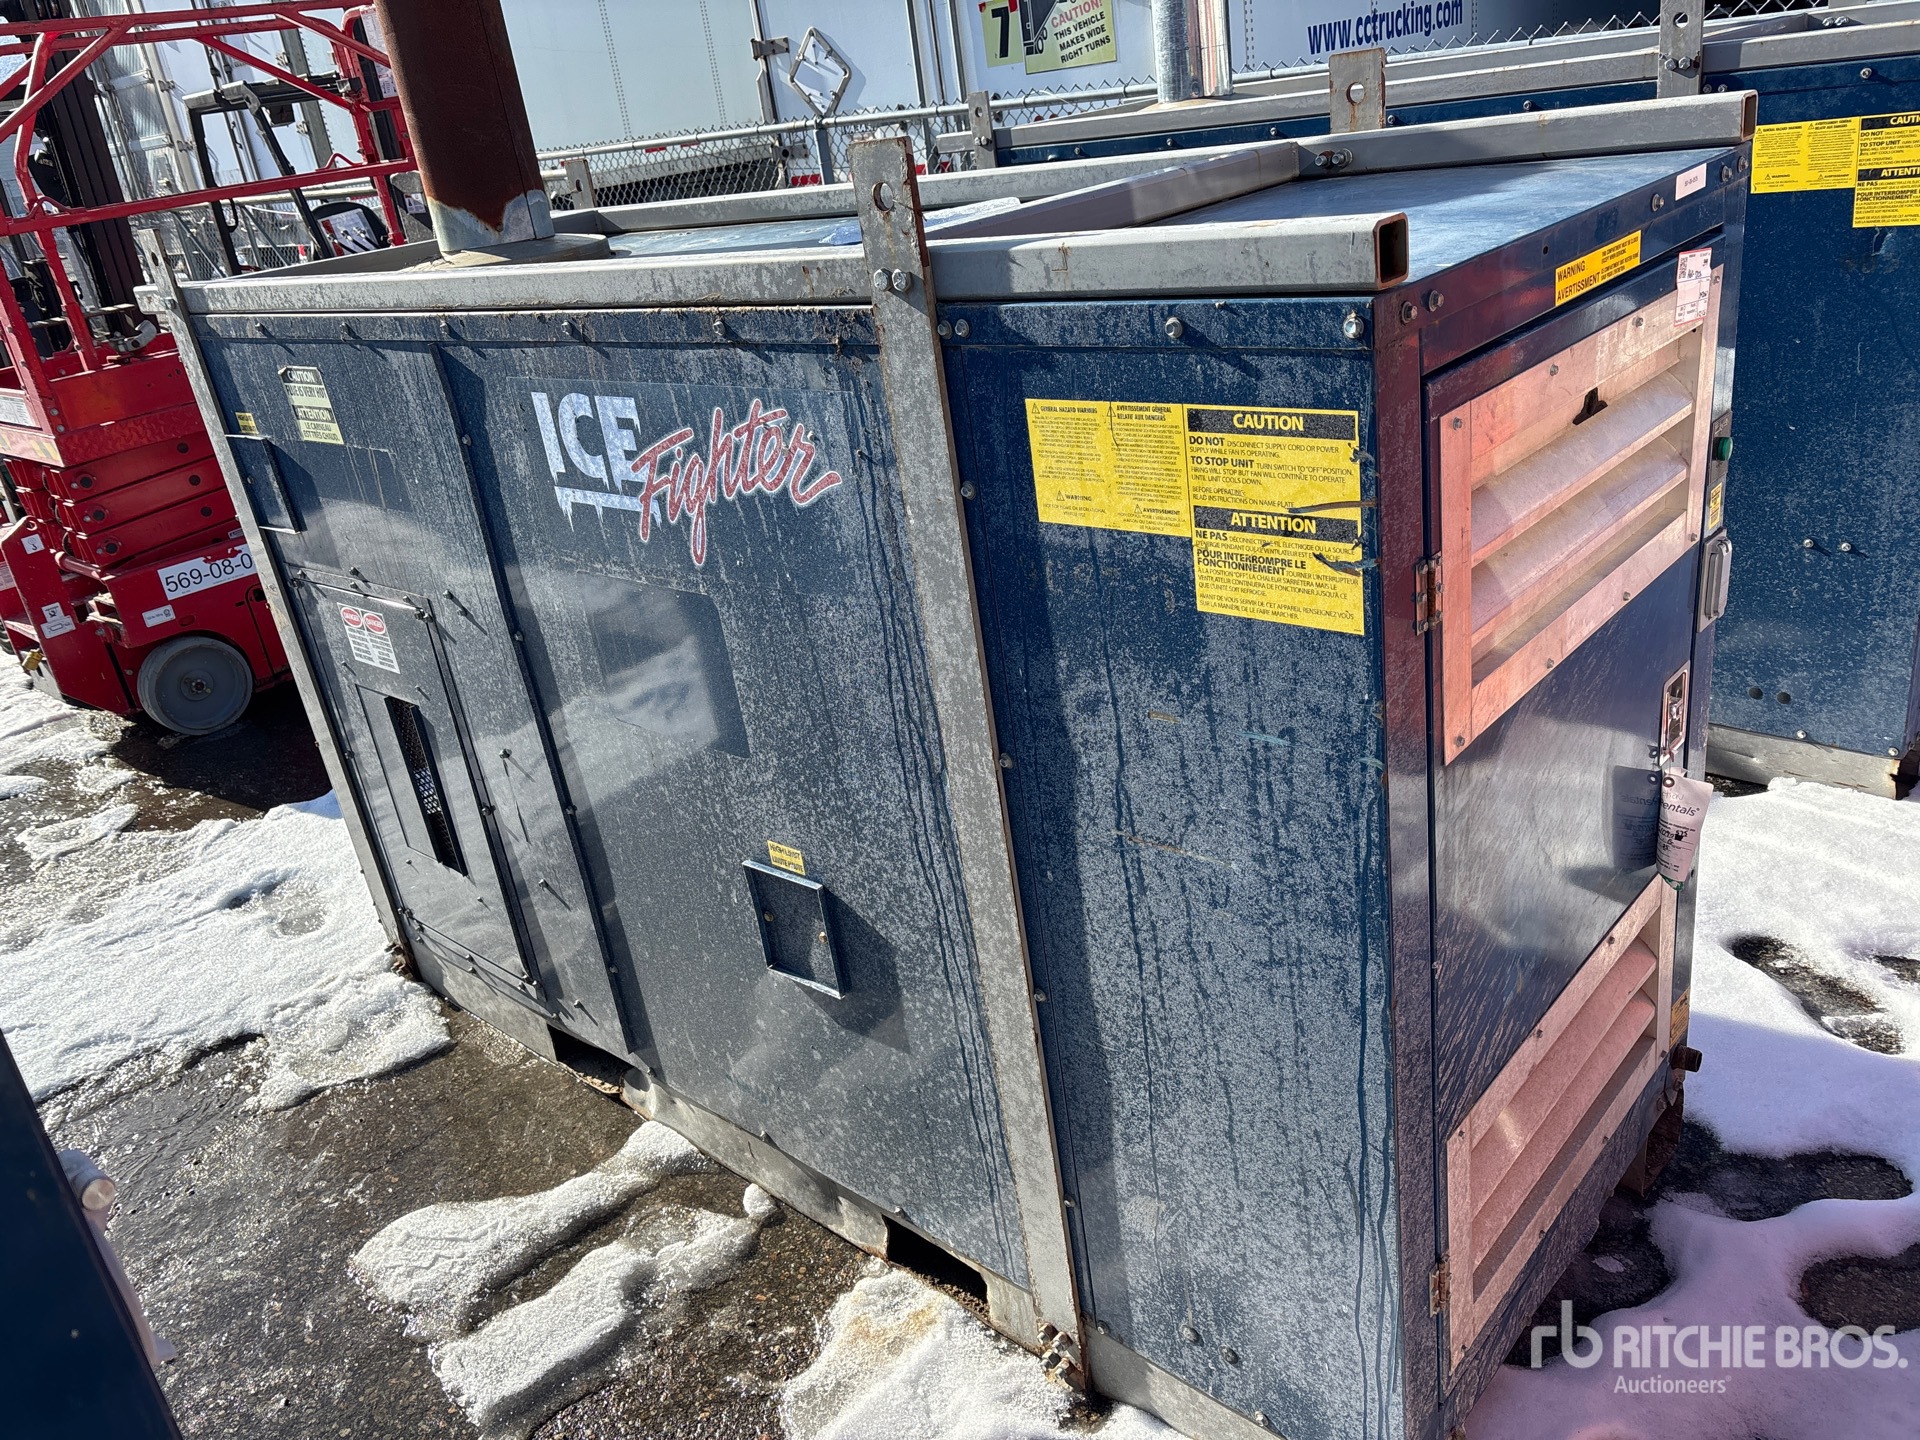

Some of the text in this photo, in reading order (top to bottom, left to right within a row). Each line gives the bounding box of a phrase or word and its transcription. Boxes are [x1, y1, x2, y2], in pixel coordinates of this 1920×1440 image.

[1051, 0, 1102, 28] CAUTION!
[1054, 11, 1106, 41] THIS VEHICLE
[1307, 0, 1463, 55] www.cctrucking.com
[1059, 24, 1107, 52] MAKES WIDE
[1060, 35, 1111, 64] RIGHT TURNS
[1890, 114, 1920, 124] CAUTI
[1558, 260, 1586, 282] WARNING
[1557, 272, 1600, 301] AVERTISSMENT
[287, 370, 316, 382] CAUTION
[296, 407, 332, 420] ATTENTION
[1232, 413, 1303, 431] CAUTION
[1189, 436, 1203, 445] DO
[1205, 436, 1224, 446] NOT
[1191, 455, 1203, 465] TO
[1204, 456, 1229, 466] STOP
[1231, 458, 1254, 468] UNIT
[531, 392, 842, 565] ICE Fighter
[1230, 511, 1316, 533] ATTENTION
[1195, 530, 1207, 538] NE
[1209, 531, 1227, 540] PAS
[1196, 548, 1306, 569] POUR INTERROMPRE LE
[1197, 557, 1285, 575] FONCTIONNEMENT
